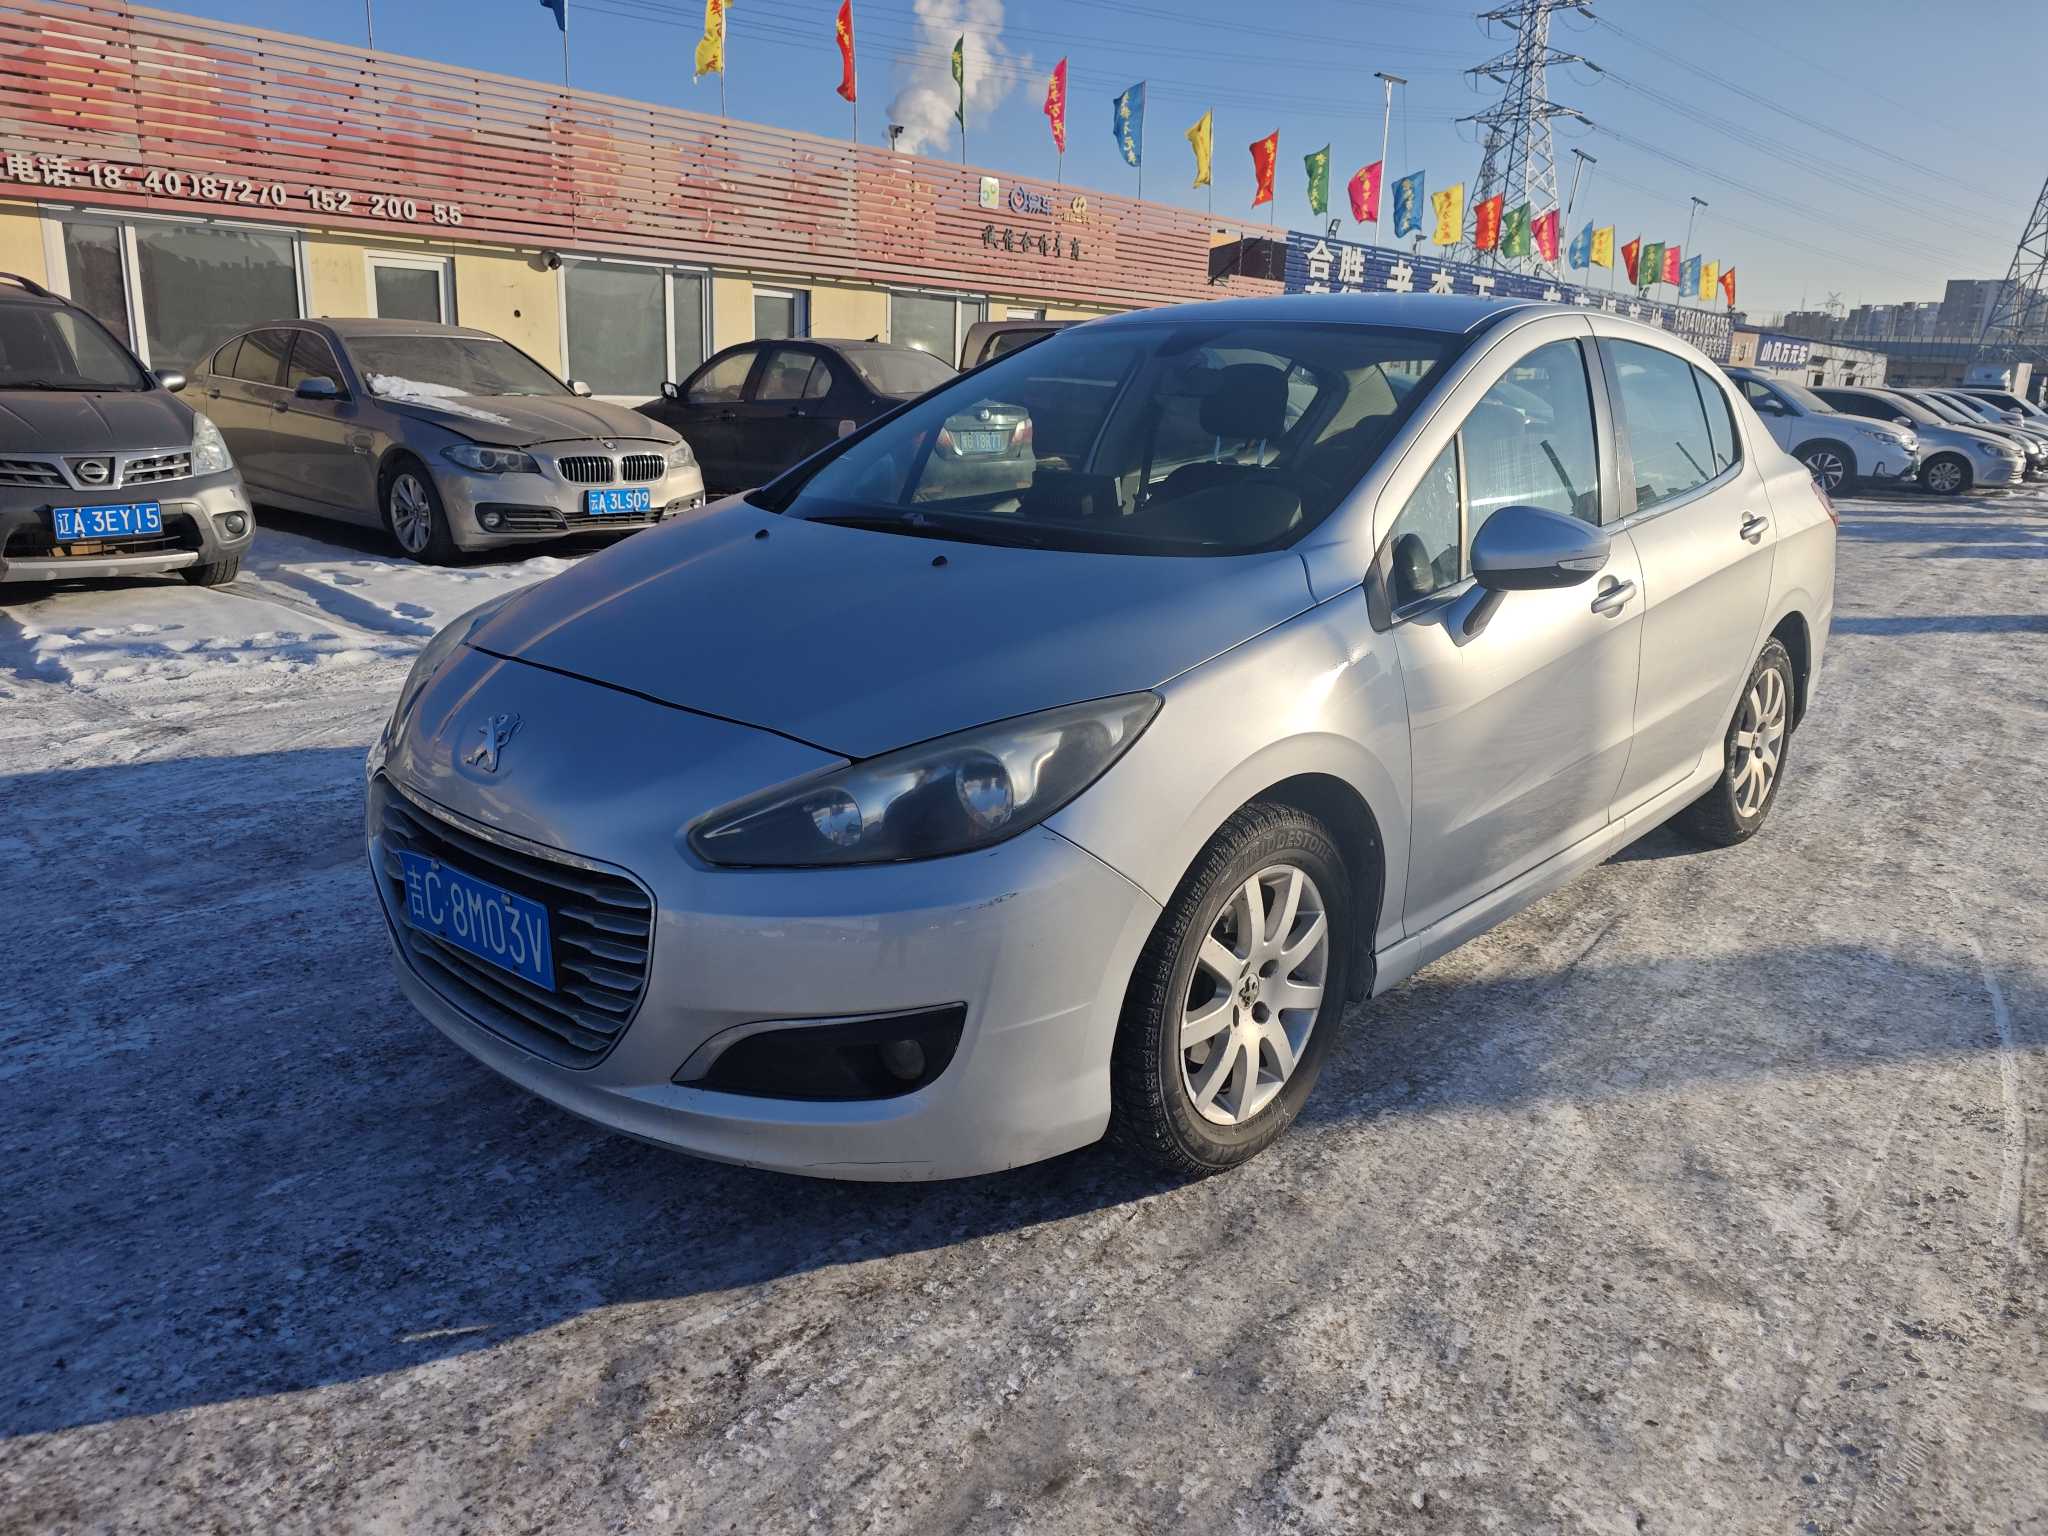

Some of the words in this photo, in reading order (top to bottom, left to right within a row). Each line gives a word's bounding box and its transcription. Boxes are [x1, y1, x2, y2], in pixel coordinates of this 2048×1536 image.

[304, 187, 353, 213] 152
[368, 194, 417, 220] 200
[431, 201, 464, 225] 55
